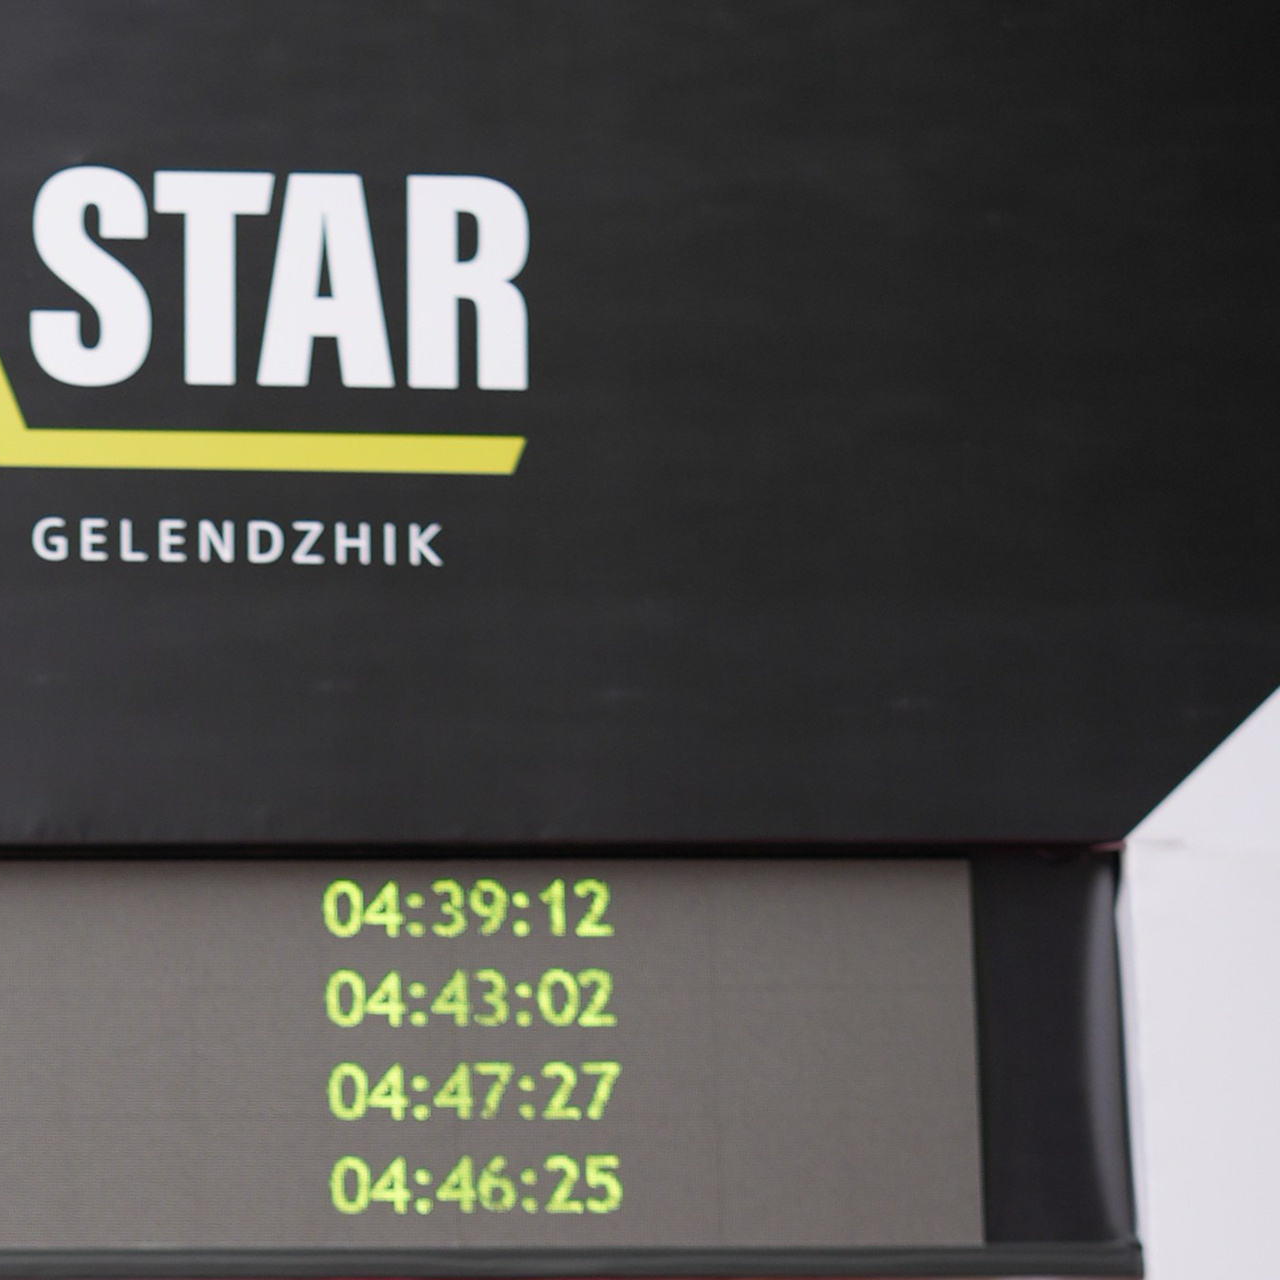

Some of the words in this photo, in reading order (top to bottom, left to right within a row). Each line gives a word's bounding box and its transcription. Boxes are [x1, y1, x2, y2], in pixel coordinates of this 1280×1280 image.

[29, 165, 529, 391] STAR
[32, 517, 442, 567] GELENDZHIK
[322, 878, 615, 938] 04:39:12
[325, 968, 618, 1027] 04:43:02
[328, 1061, 622, 1121] 04:47:27
[330, 1154, 623, 1214] 04:46:25
